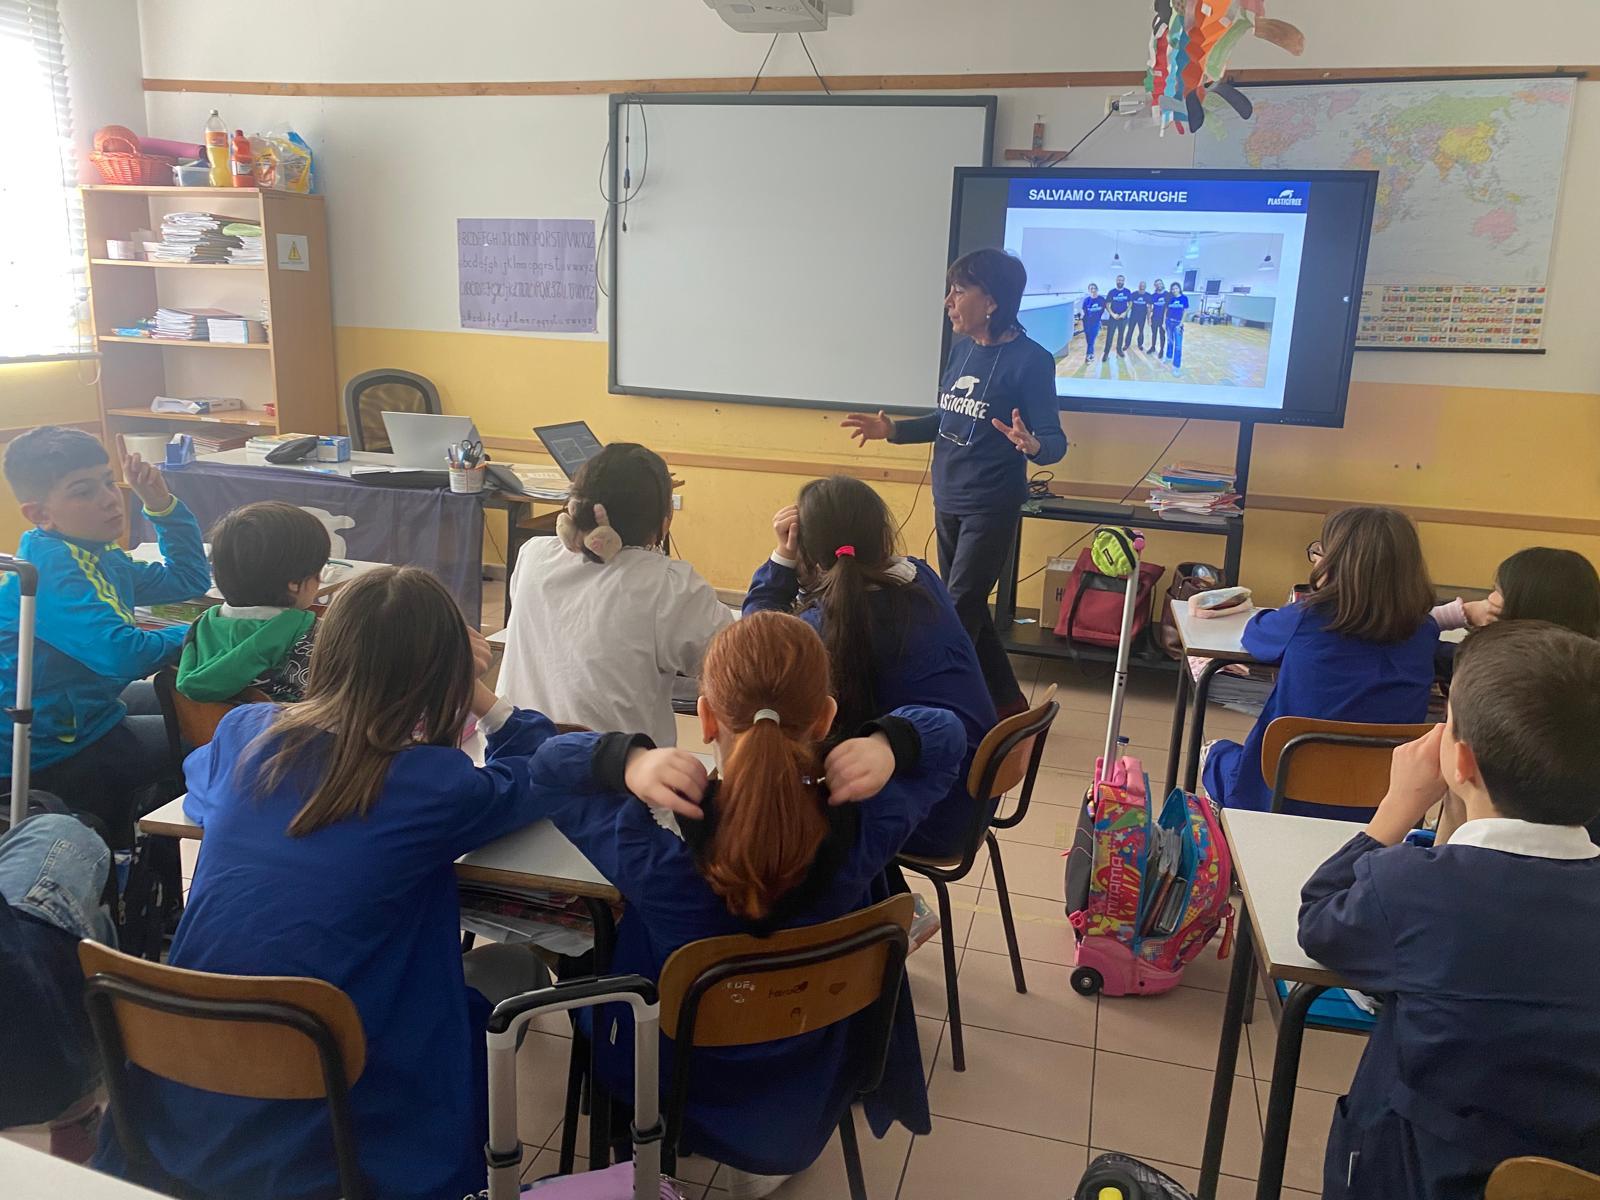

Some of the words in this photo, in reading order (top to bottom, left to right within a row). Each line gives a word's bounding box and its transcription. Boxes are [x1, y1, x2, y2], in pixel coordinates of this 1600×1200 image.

[1028, 189, 1095, 201] SALVIAMO
[1098, 190, 1188, 203] TARTARUGHE
[1106, 856, 1124, 917] MITAMA
